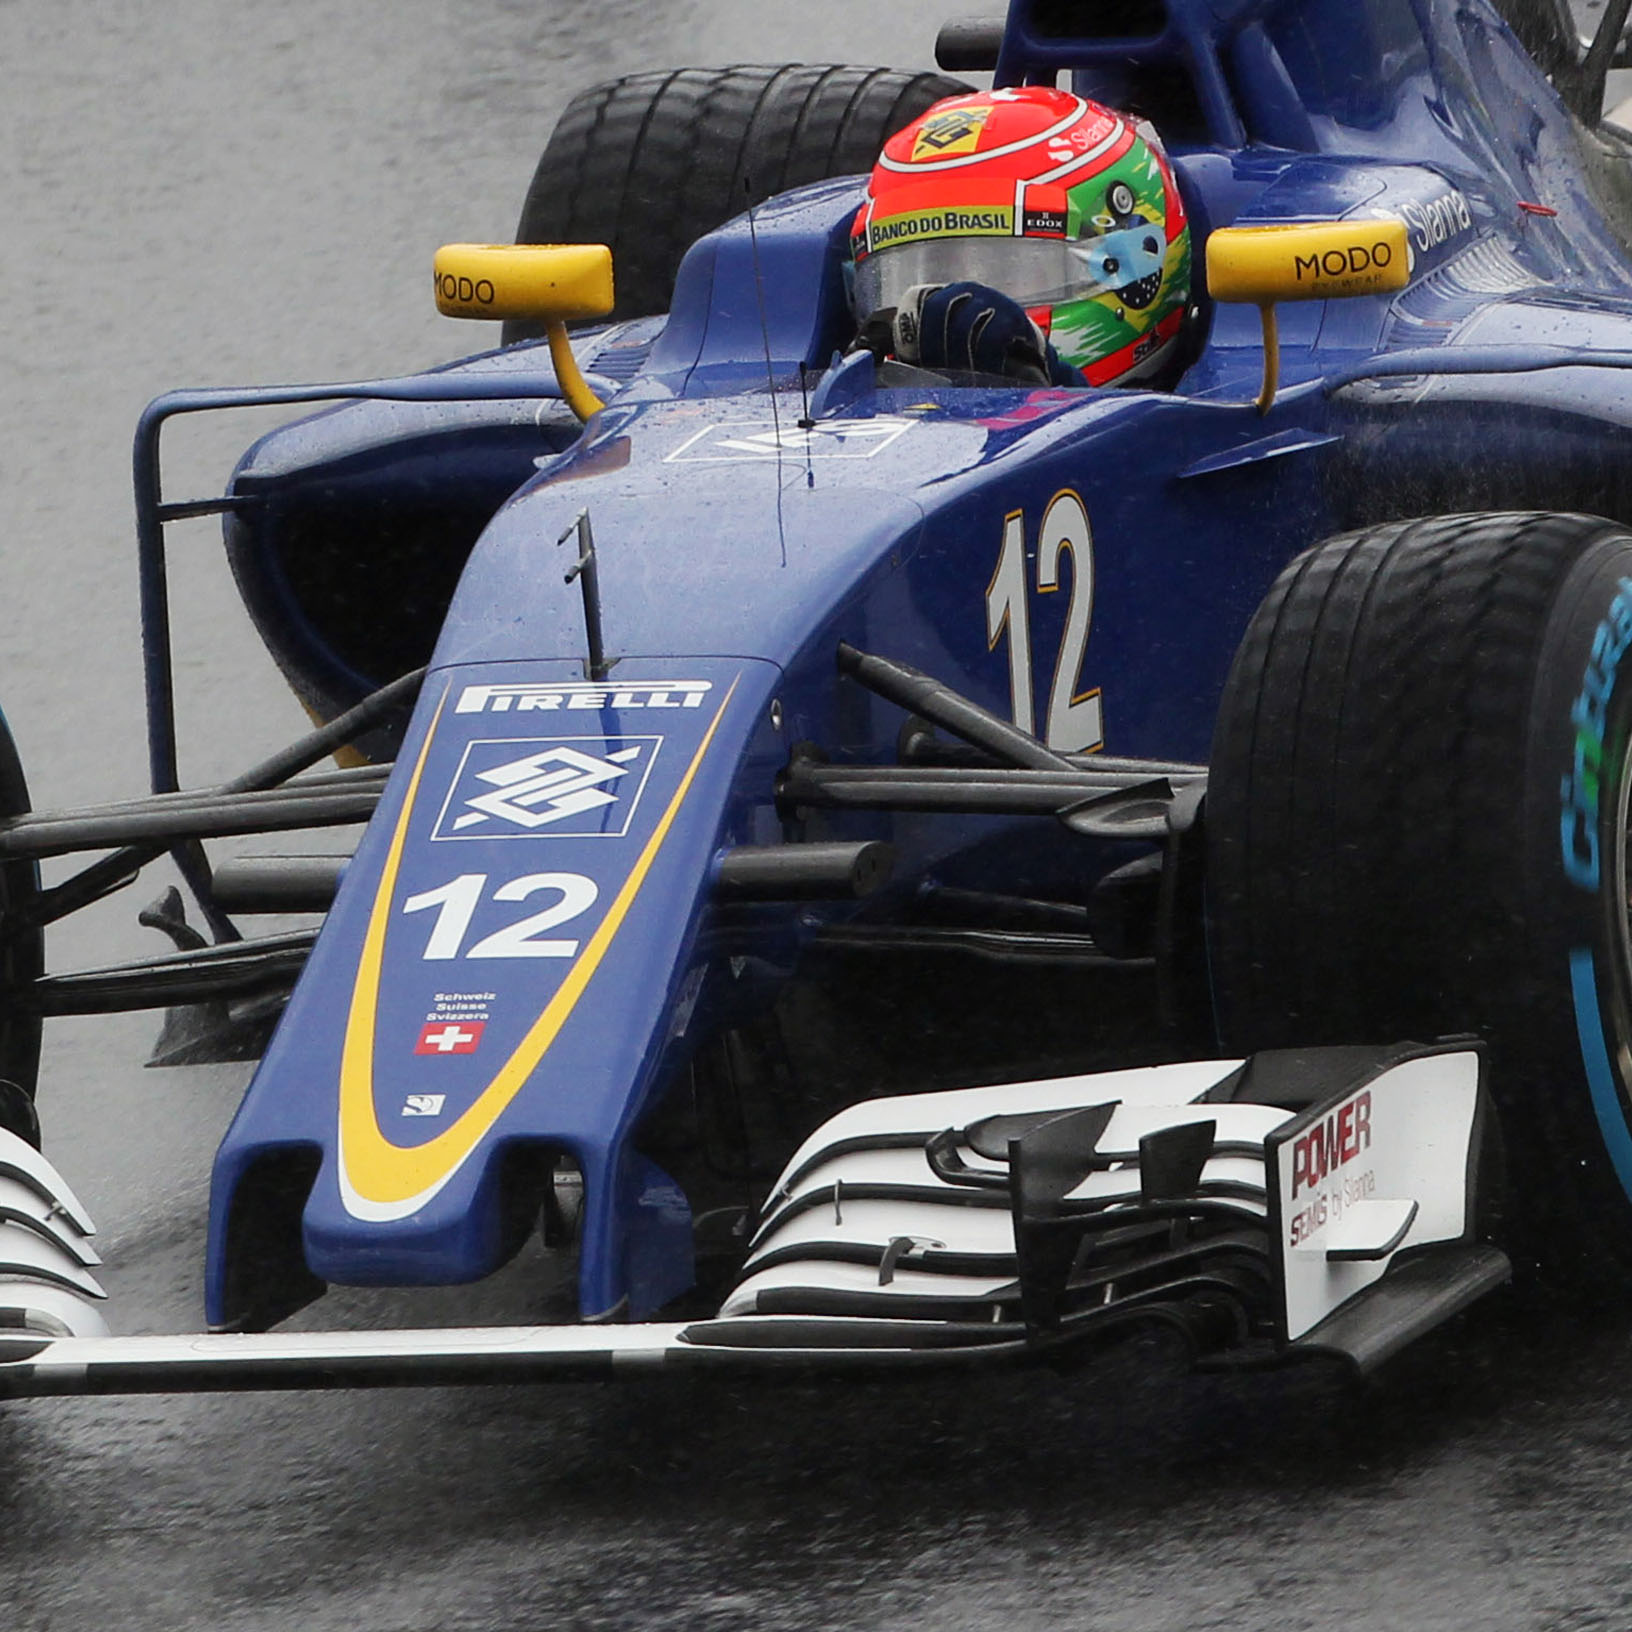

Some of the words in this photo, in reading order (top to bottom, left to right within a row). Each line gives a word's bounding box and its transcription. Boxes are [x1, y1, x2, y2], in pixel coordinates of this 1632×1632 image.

[872, 219, 918, 245] BANCO
[919, 215, 943, 233] DO
[944, 212, 1010, 230] BRASIL
[1027, 219, 1063, 228] EDOX
[1401, 188, 1472, 252] Silanna
[1294, 241, 1392, 280] MODO
[985, 487, 1105, 754] 12
[455, 680, 714, 714] PIRELLI
[402, 872, 599, 960] 12
[433, 992, 497, 1002] Schweiz
[435, 1002, 487, 1011] Suisse
[426, 1012, 489, 1021] Svizzera
[1291, 1089, 1372, 1201] POWER
